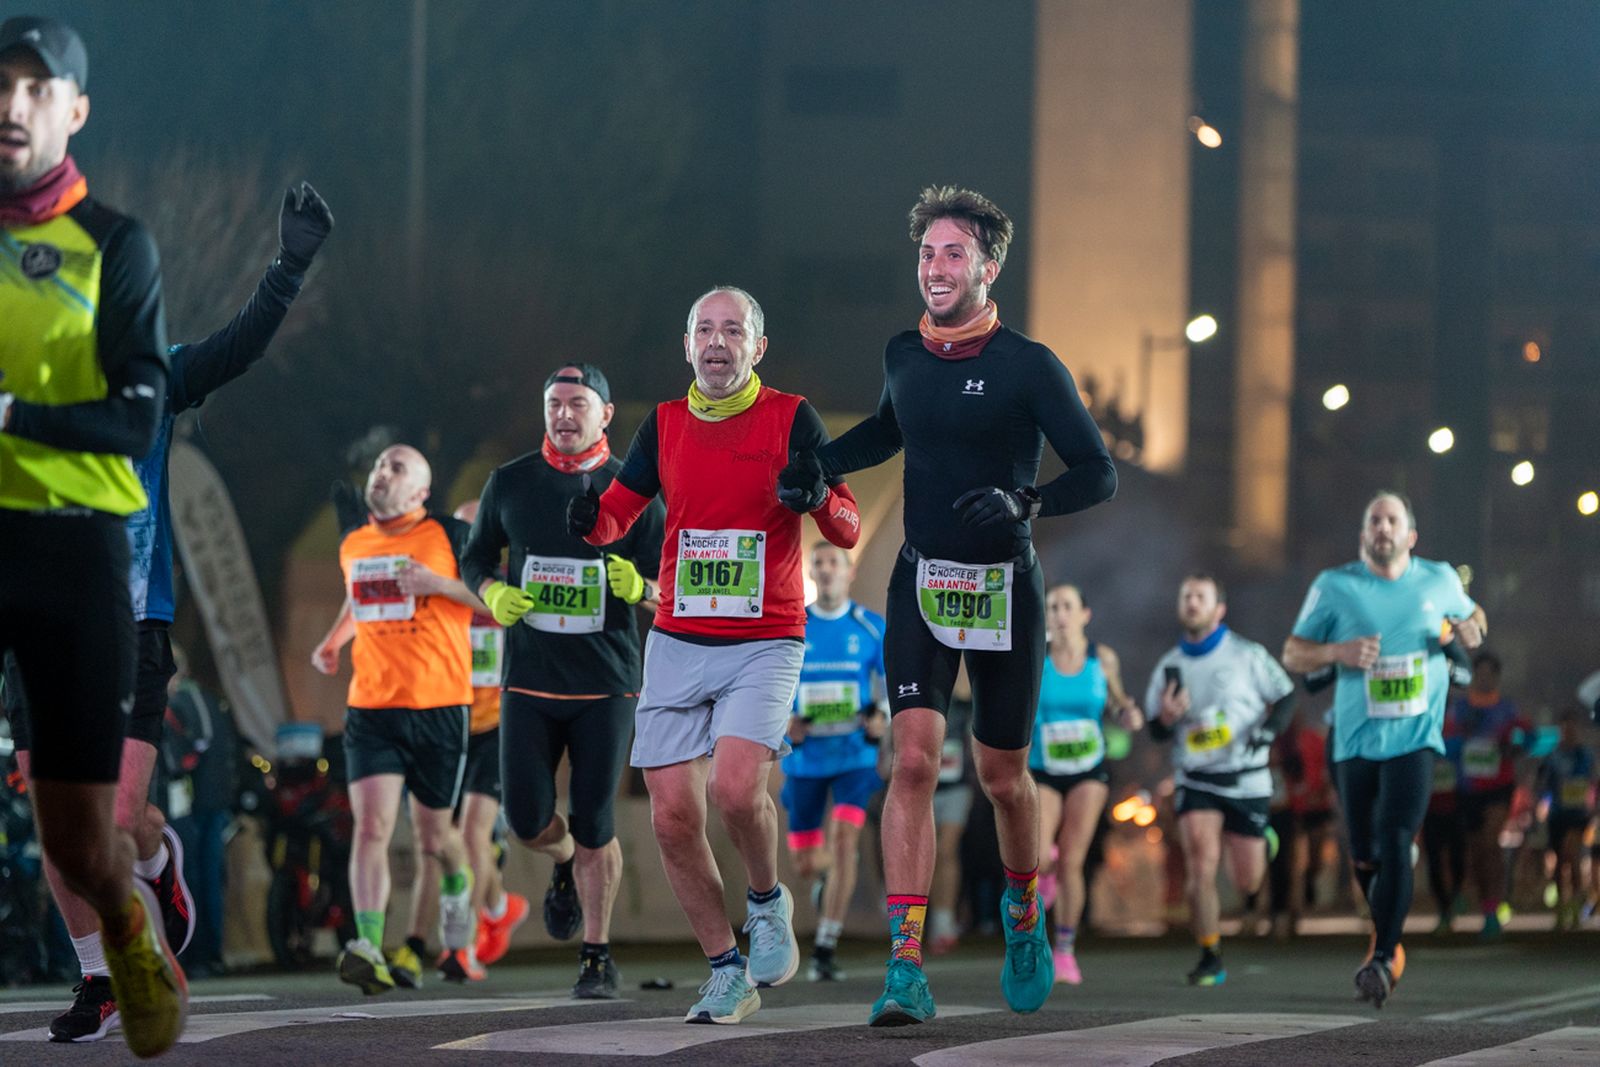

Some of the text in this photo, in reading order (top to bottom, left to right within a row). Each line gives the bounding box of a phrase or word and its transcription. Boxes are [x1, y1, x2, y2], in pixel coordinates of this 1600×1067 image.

[691, 539, 718, 548] NOCHE
[532, 574, 548, 583] SAN
[690, 560, 744, 587] 9167
[938, 568, 966, 579] NOCHE
[967, 571, 977, 580] DE
[928, 579, 945, 589] SAN
[538, 584, 588, 609] 4621
[935, 591, 992, 619] 1990
